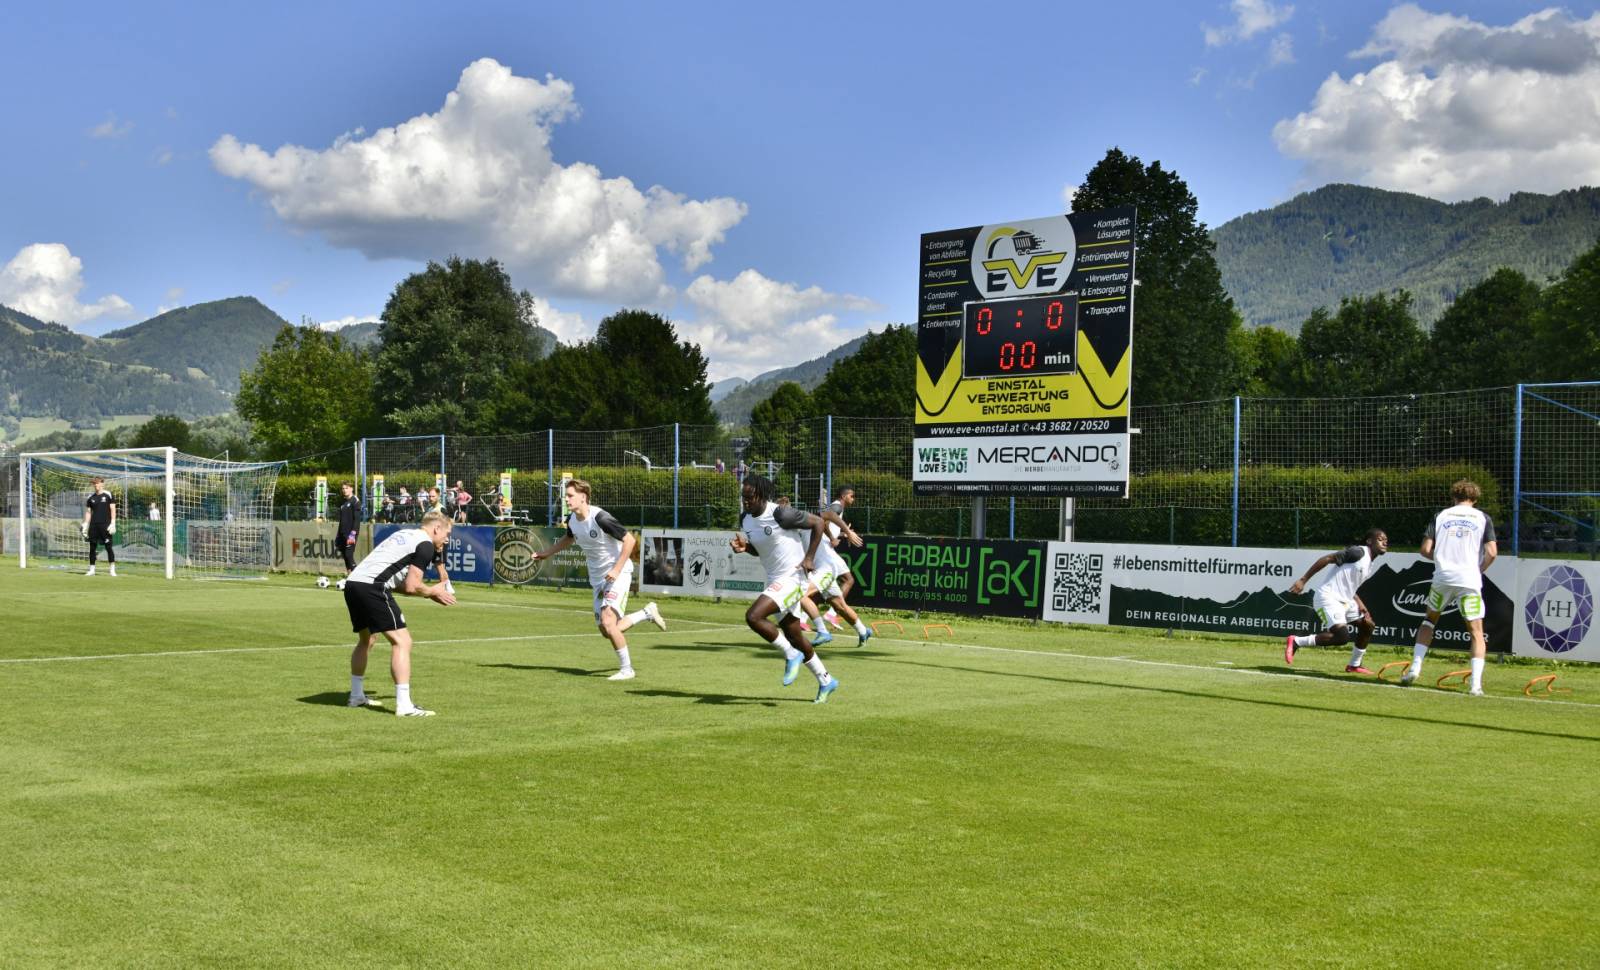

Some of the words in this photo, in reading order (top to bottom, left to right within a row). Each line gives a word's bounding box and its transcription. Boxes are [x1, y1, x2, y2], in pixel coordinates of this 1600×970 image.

[1097, 229, 1130, 239] Lösungen
[929, 240, 964, 249] Entsorgung
[1081, 250, 1129, 262] Entrümpelung
[928, 269, 957, 279] Recycling
[1090, 273, 1128, 282] Verwertung
[1087, 285, 1126, 296] Entsorgung
[927, 302, 945, 311] dienst
[1090, 305, 1126, 316] Transporte
[977, 307, 992, 335] 0
[1046, 301, 1063, 330] 0
[926, 320, 961, 329] Entkernung
[1000, 341, 1036, 370] 00
[1044, 352, 1071, 366] min
[988, 379, 1046, 391] ENNSTAL
[967, 390, 1069, 404] VERWERTUNG
[982, 405, 1051, 415] ENTSORGUNG
[930, 421, 1020, 436] www.eve-ennstal.at
[1049, 421, 1071, 432] 3682
[1080, 420, 1110, 431] 20520
[918, 448, 941, 462] WE
[949, 448, 968, 461] WE
[978, 445, 1118, 464] MERCANDO
[919, 463, 940, 473] LOVE
[948, 461, 968, 474] DO!
[885, 544, 971, 568] ERDBAU
[1113, 555, 1293, 577] #lebensmittelfürmarken
[884, 567, 930, 588] alfred
[935, 569, 969, 590] köhl
[944, 593, 968, 603] 4000
[1126, 609, 1151, 620] DEIN
[1155, 611, 1227, 625] REGIONALER
[1230, 616, 1310, 631] ARBEITGEBER
